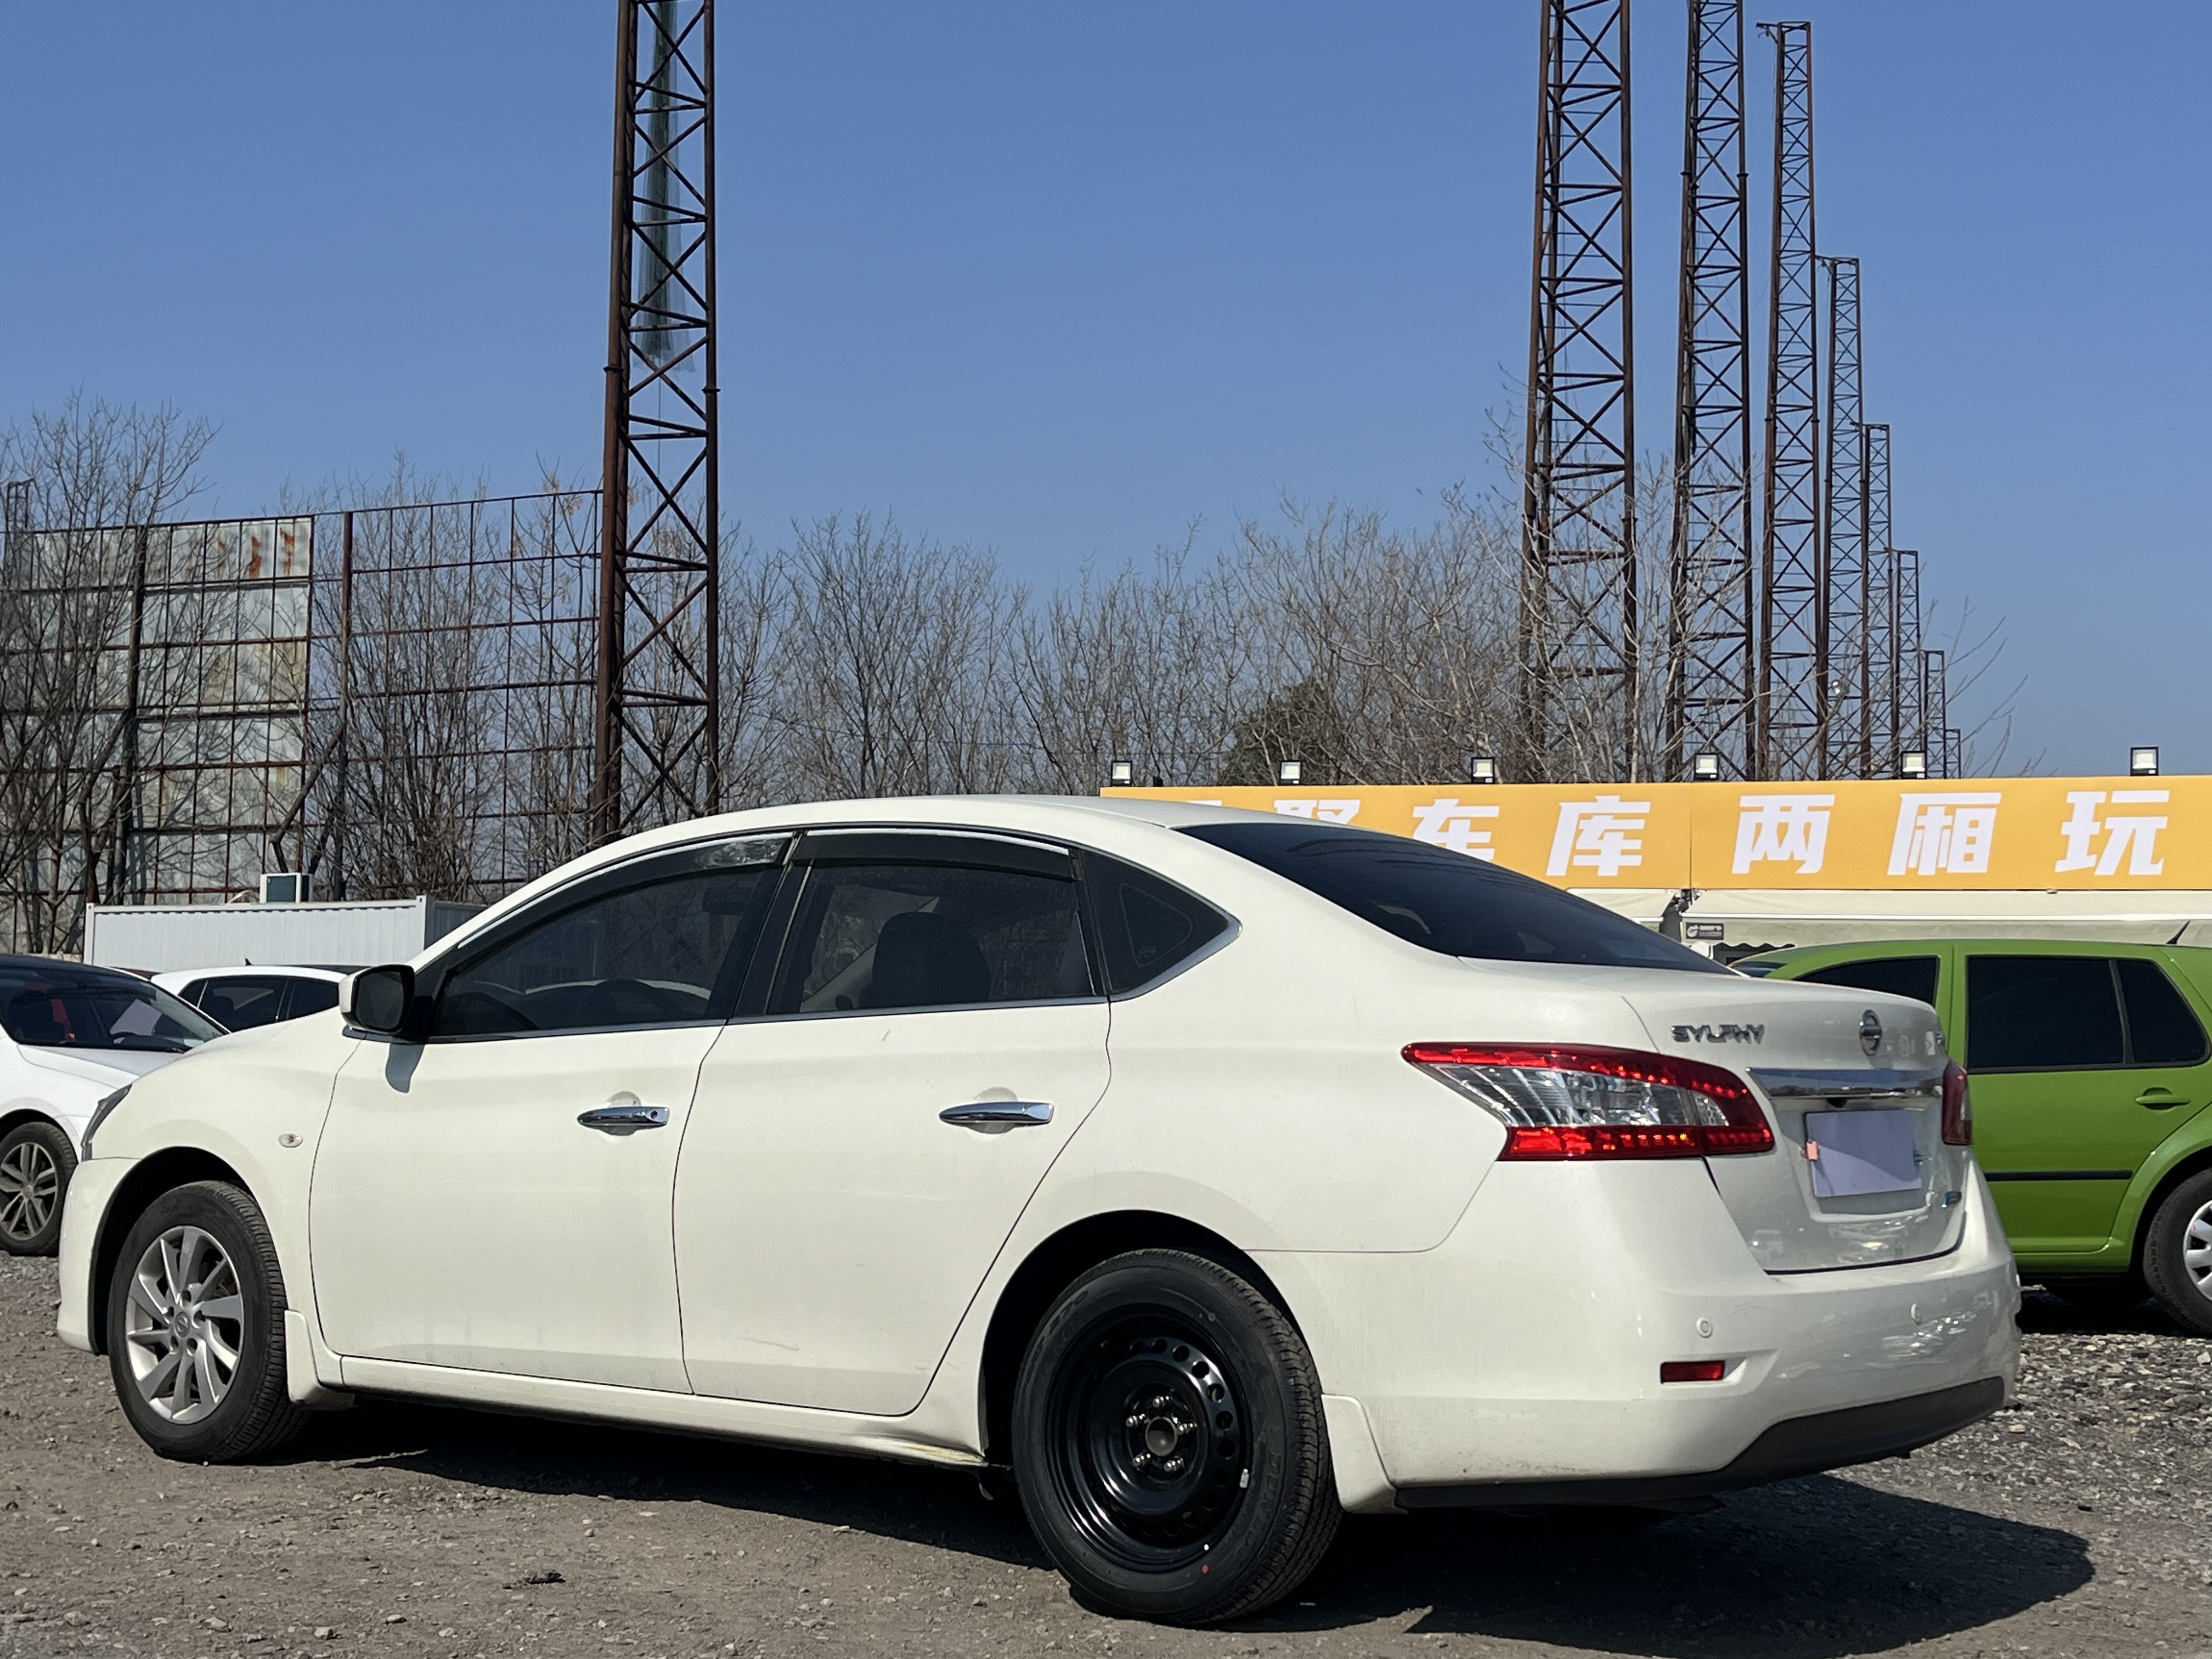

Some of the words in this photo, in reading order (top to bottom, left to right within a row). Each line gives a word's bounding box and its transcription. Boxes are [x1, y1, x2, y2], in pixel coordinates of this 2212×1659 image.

[1187, 790, 2170, 876] 车库两厢玩
